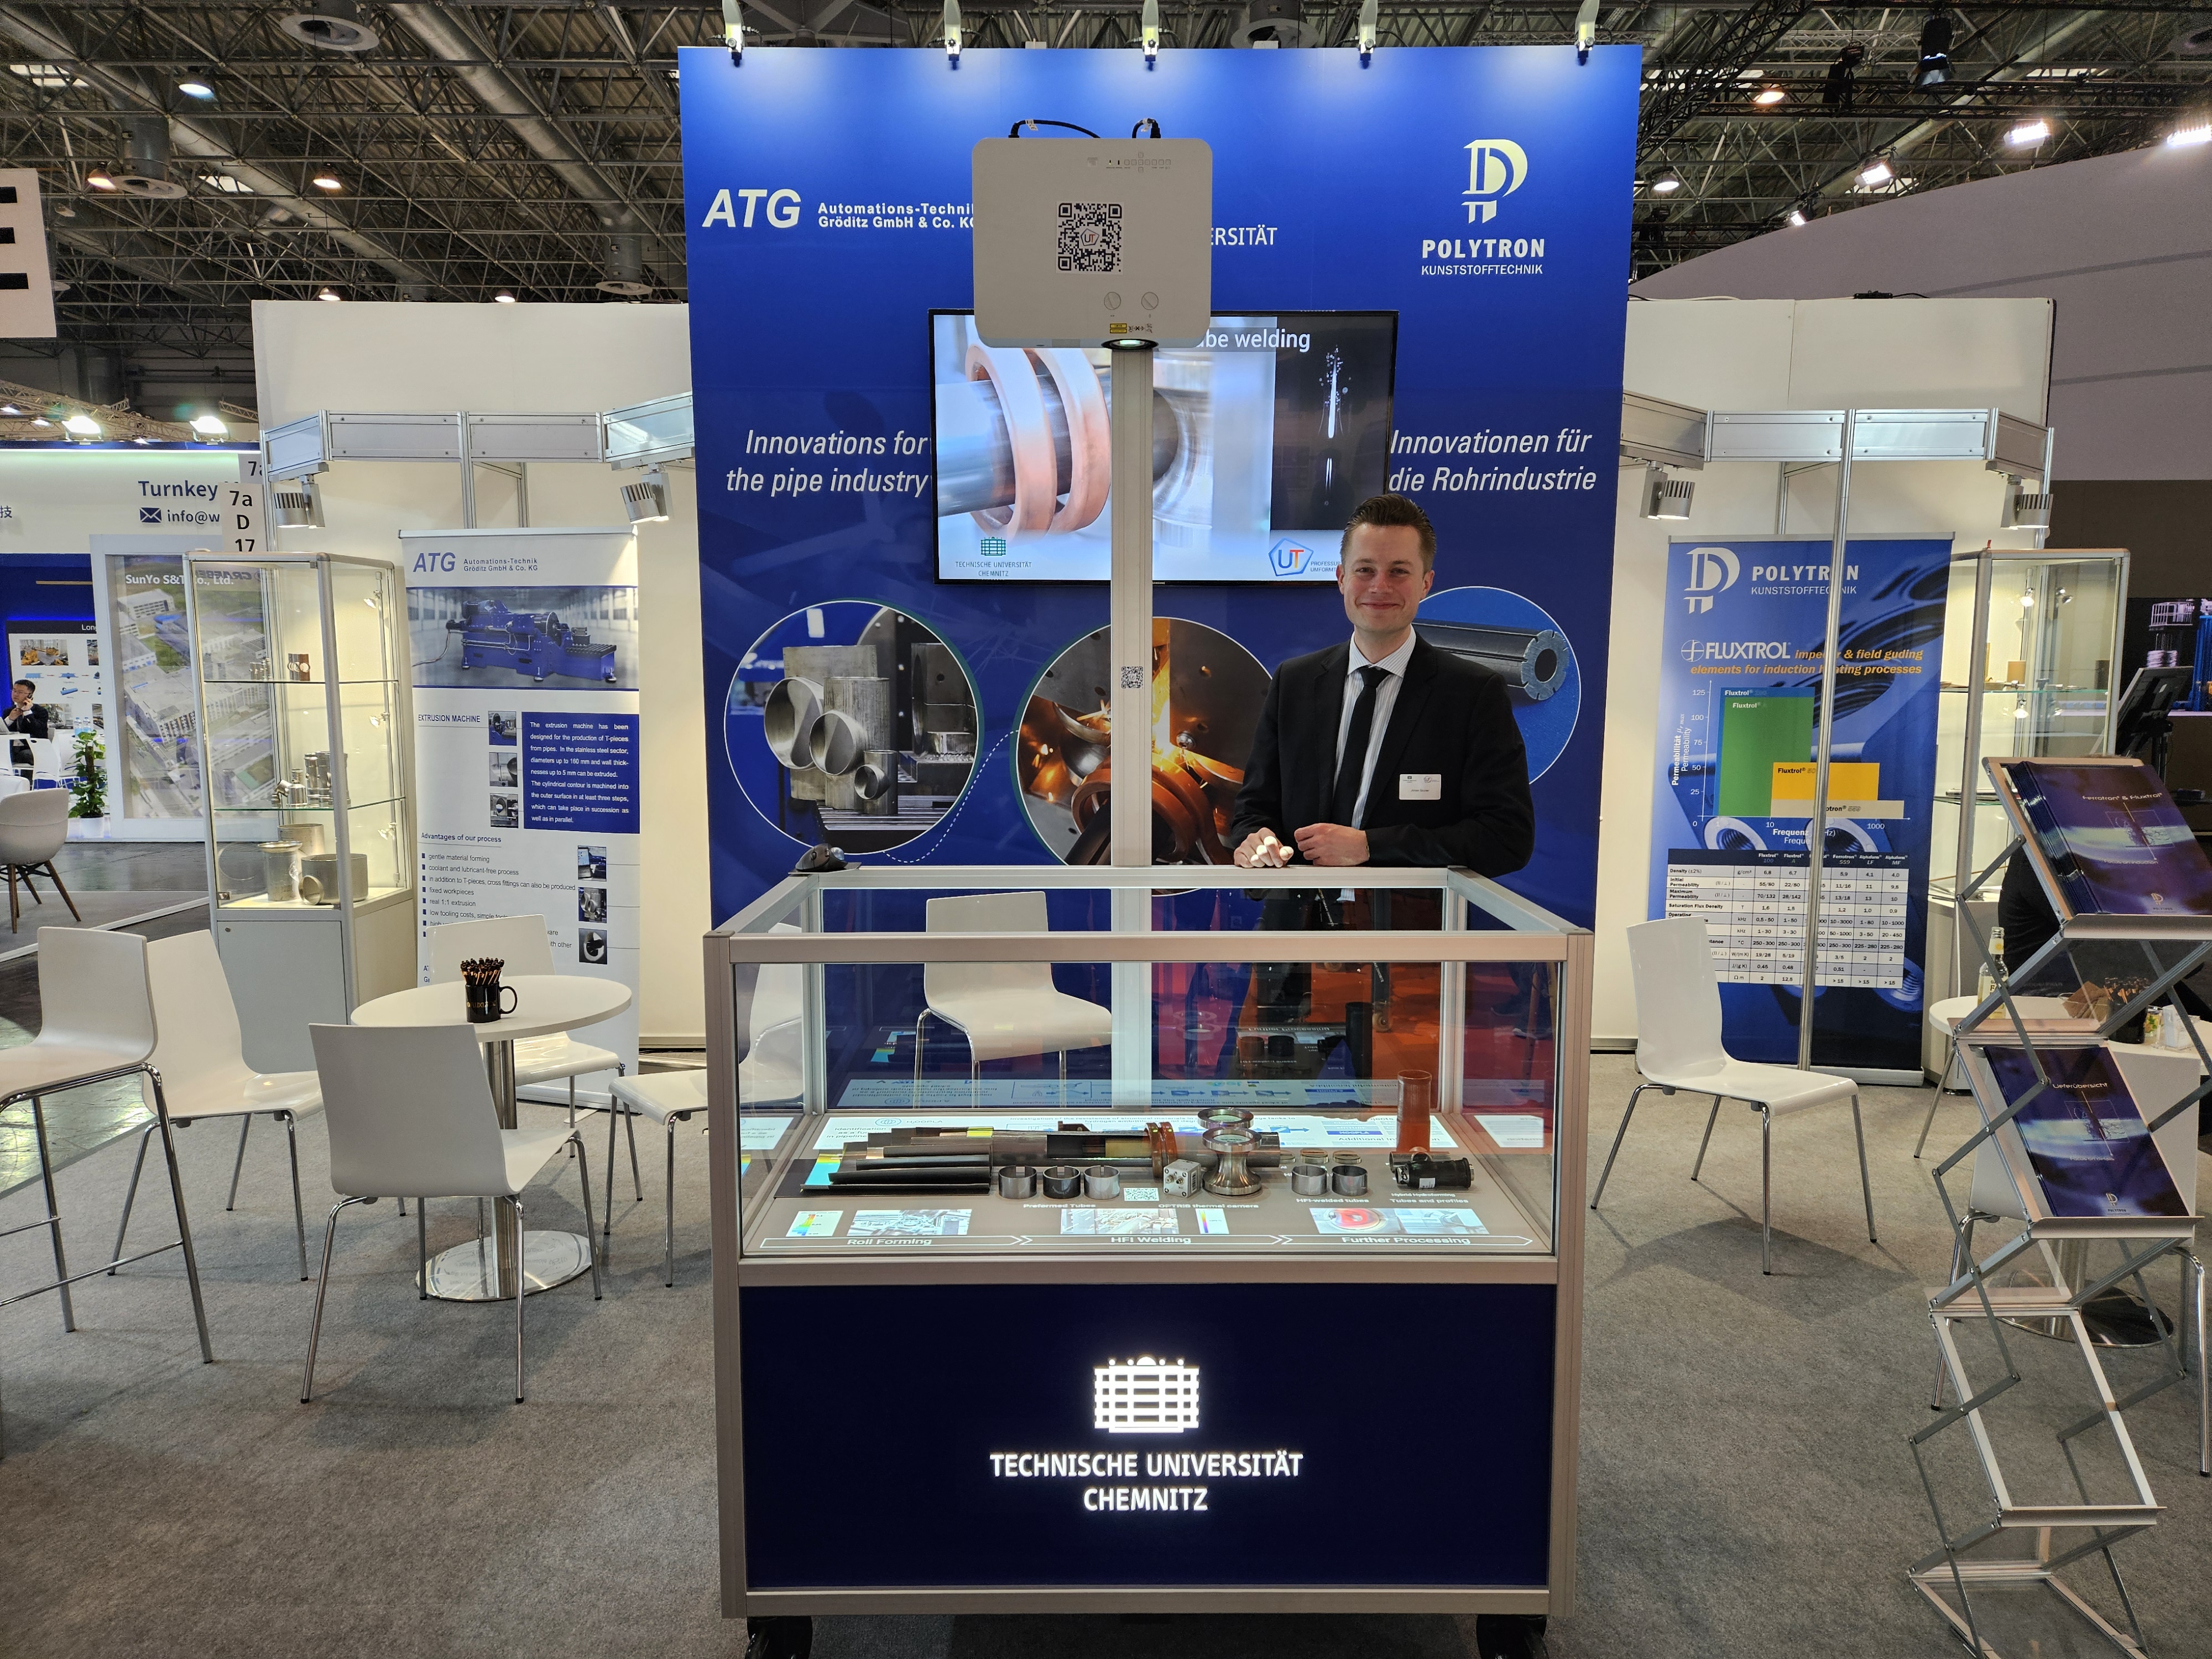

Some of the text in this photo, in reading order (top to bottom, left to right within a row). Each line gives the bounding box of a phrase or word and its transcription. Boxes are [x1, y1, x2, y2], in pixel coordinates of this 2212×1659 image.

[702, 189, 801, 228] ATG
[818, 203, 973, 215] Automations-Techni
[818, 216, 868, 228] Gröditz
[873, 216, 913, 228] GmbH
[918, 217, 927, 228] &
[932, 217, 954, 228] Co.
[1211, 225, 1277, 246] RSITÄT
[1422, 238, 1544, 258] POLYTRON
[1422, 264, 1543, 275] KUNSTSTOFFTECHNIK
[1197, 329, 1311, 352] be welding
[746, 430, 928, 455] Innovations for
[1390, 428, 1593, 454] Innovationen für
[727, 467, 928, 498] the pipe industry
[1389, 466, 1596, 491] die Rohrindustrie
[138, 479, 218, 500] Turnkey
[229, 490, 253, 507] 7a
[167, 509, 220, 525] info@w
[237, 514, 250, 530] D
[413, 552, 456, 572] ATG
[126, 574, 160, 585] SunYo
[213, 575, 234, 585] Ltd.
[1752, 565, 1859, 581] POLYTRN
[1844, 649, 1853, 659] &
[1856, 649, 1881, 659] field
[1883, 649, 1924, 661] guding
[1691, 665, 1741, 675] elements
[1744, 665, 1761, 674] for
[1763, 665, 1815, 674] induction
[1864, 665, 1922, 675] processes
[421, 833, 456, 841] Advantages
[502, 880, 519, 888] fittings
[990, 1451, 1303, 1476] TECHNISCHE UNIVERSITÄT
[1084, 1489, 1207, 1510] CHEMNITZ
